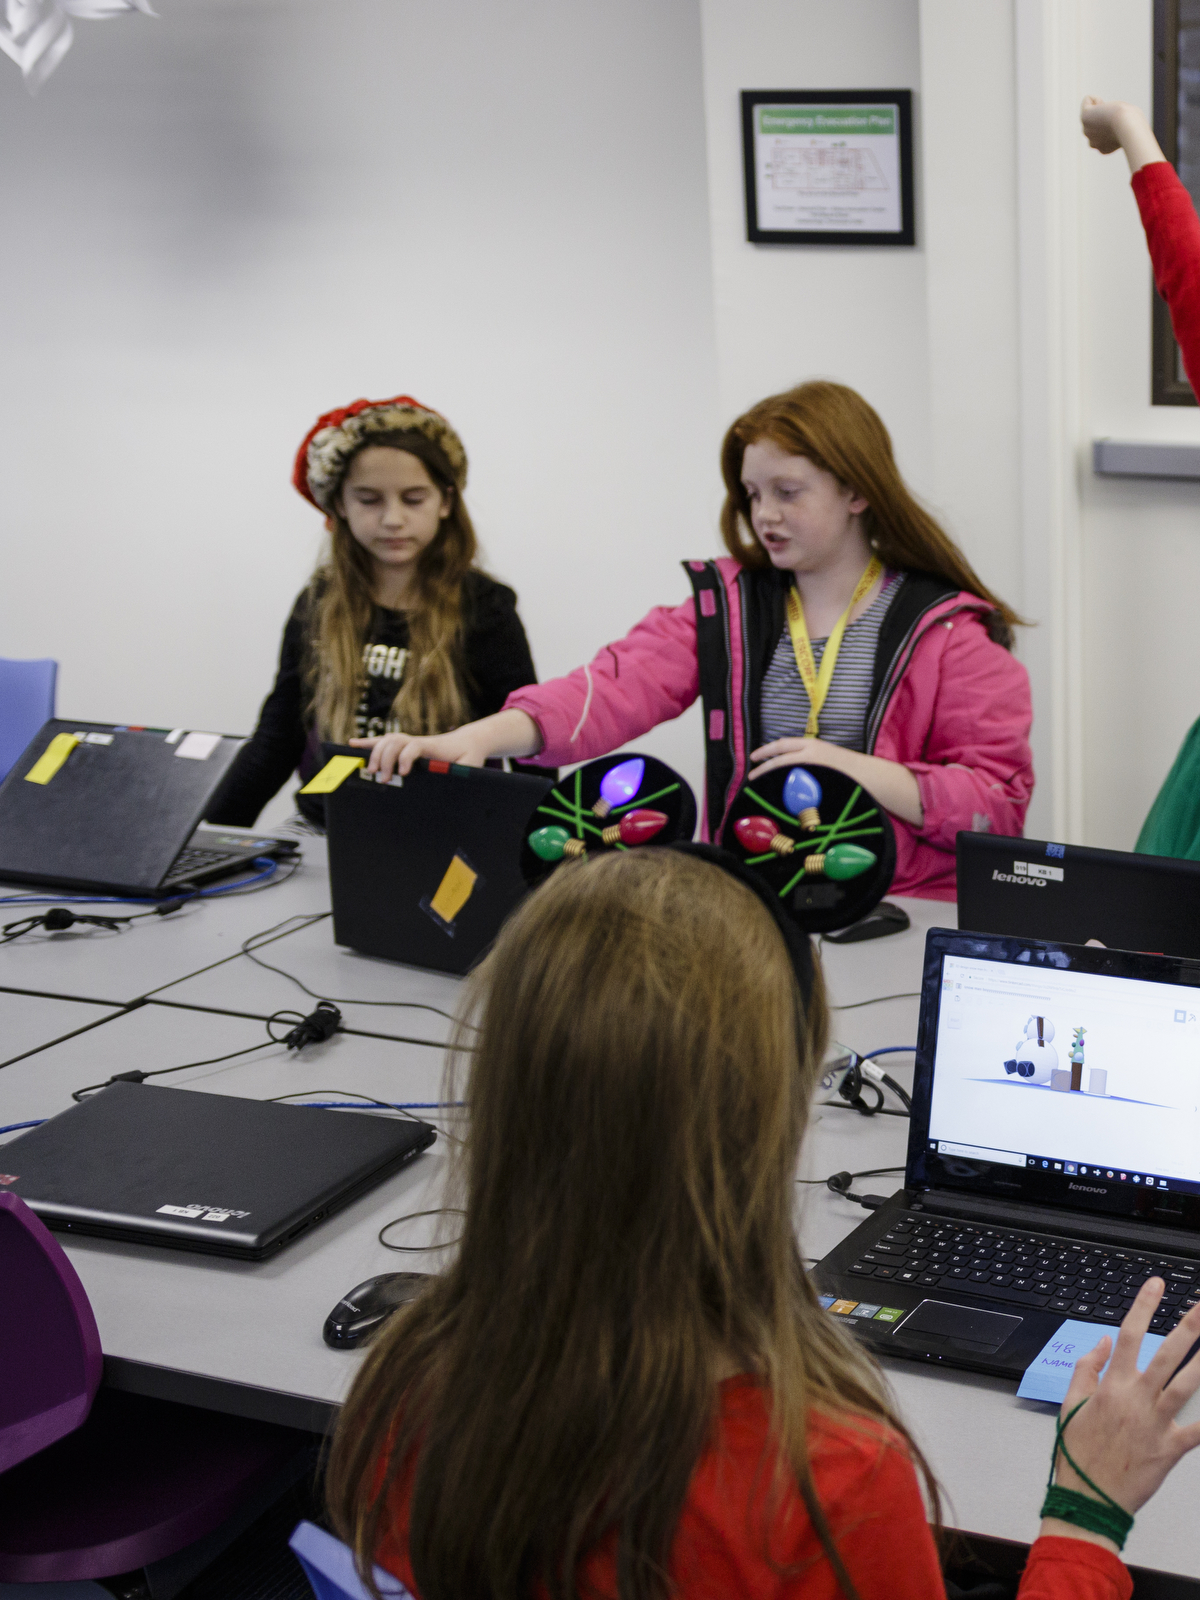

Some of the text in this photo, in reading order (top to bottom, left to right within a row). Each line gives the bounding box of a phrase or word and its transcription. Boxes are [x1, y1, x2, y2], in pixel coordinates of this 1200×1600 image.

[992, 869, 1047, 887] lenovo
[1068, 1182, 1107, 1195] lenovo
[186, 1204, 251, 1218] lenovo
